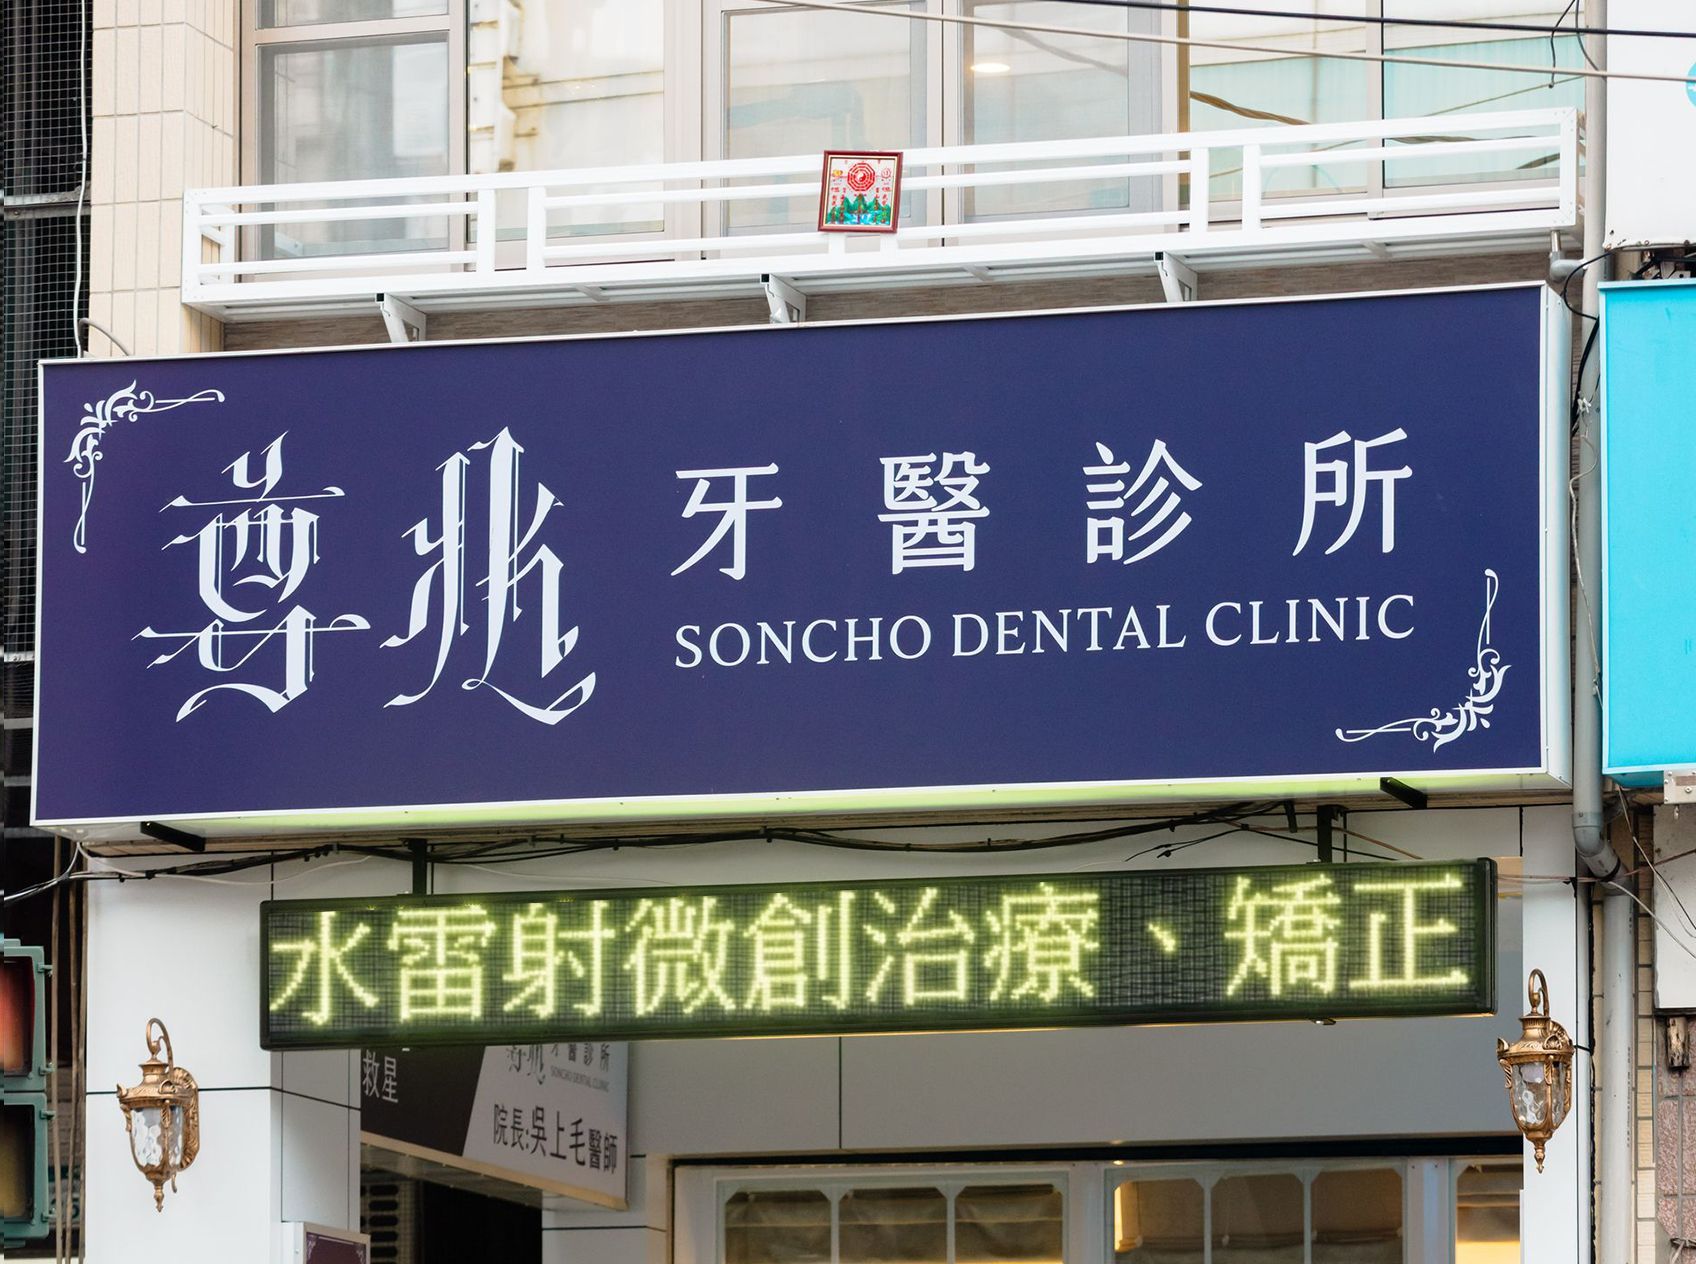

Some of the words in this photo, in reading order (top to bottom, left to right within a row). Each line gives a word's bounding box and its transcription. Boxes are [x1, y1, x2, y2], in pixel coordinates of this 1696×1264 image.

[671, 428, 1413, 580] 牙醫診所
[674, 615, 933, 669] SONCHO
[952, 605, 1187, 657] DENTAL
[1205, 594, 1415, 646] CLINIC
[361, 1049, 399, 1103] 救星
